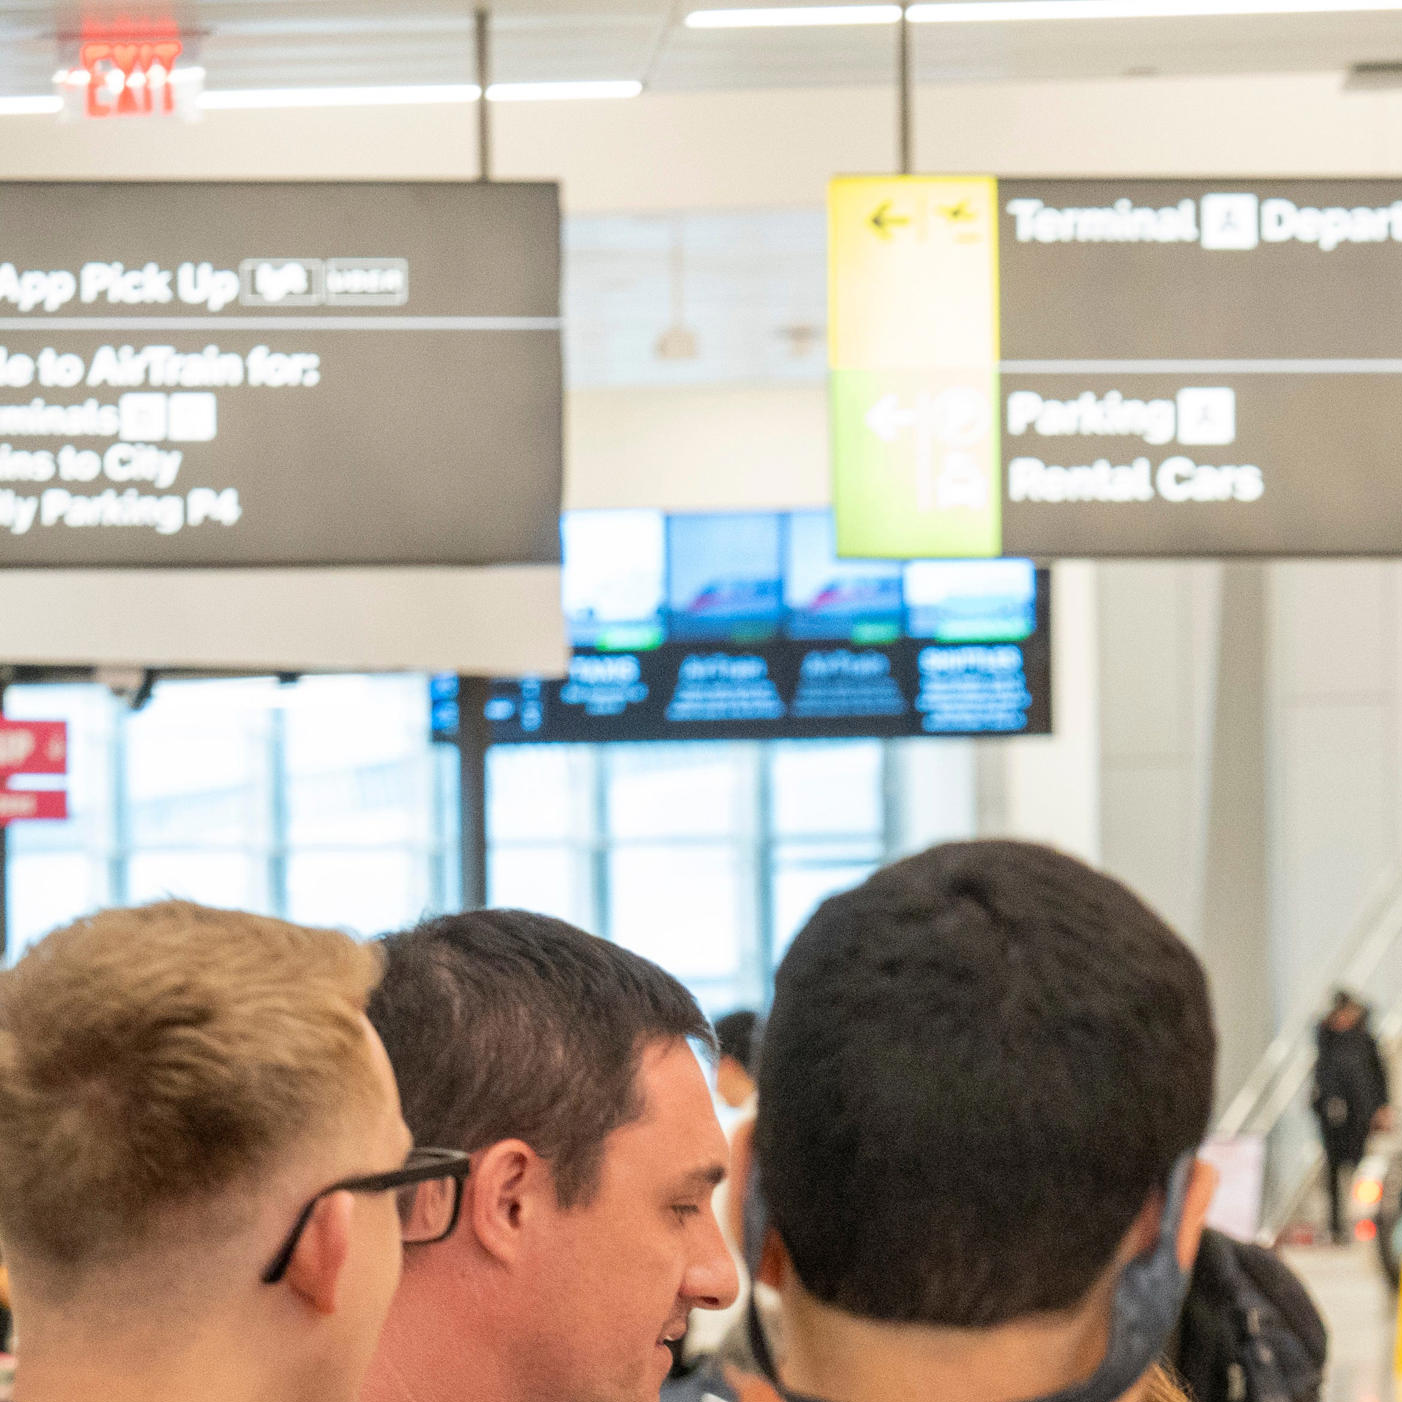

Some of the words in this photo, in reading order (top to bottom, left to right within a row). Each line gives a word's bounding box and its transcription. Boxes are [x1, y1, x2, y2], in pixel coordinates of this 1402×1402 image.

[1007, 198, 1198, 242] Terminal
[0, 262, 75, 310] App
[81, 262, 172, 302] Pick
[178, 262, 240, 311] Up
[38, 347, 84, 386] to
[87, 345, 243, 386] AirTrain
[247, 345, 319, 386] for:
[1007, 390, 1176, 445] Parking
[58, 444, 101, 481] to
[103, 443, 182, 488] City
[1008, 456, 1155, 503] Rental
[1156, 456, 1264, 502] Cars
[41, 488, 184, 534] Parking
[187, 488, 241, 526] P4
